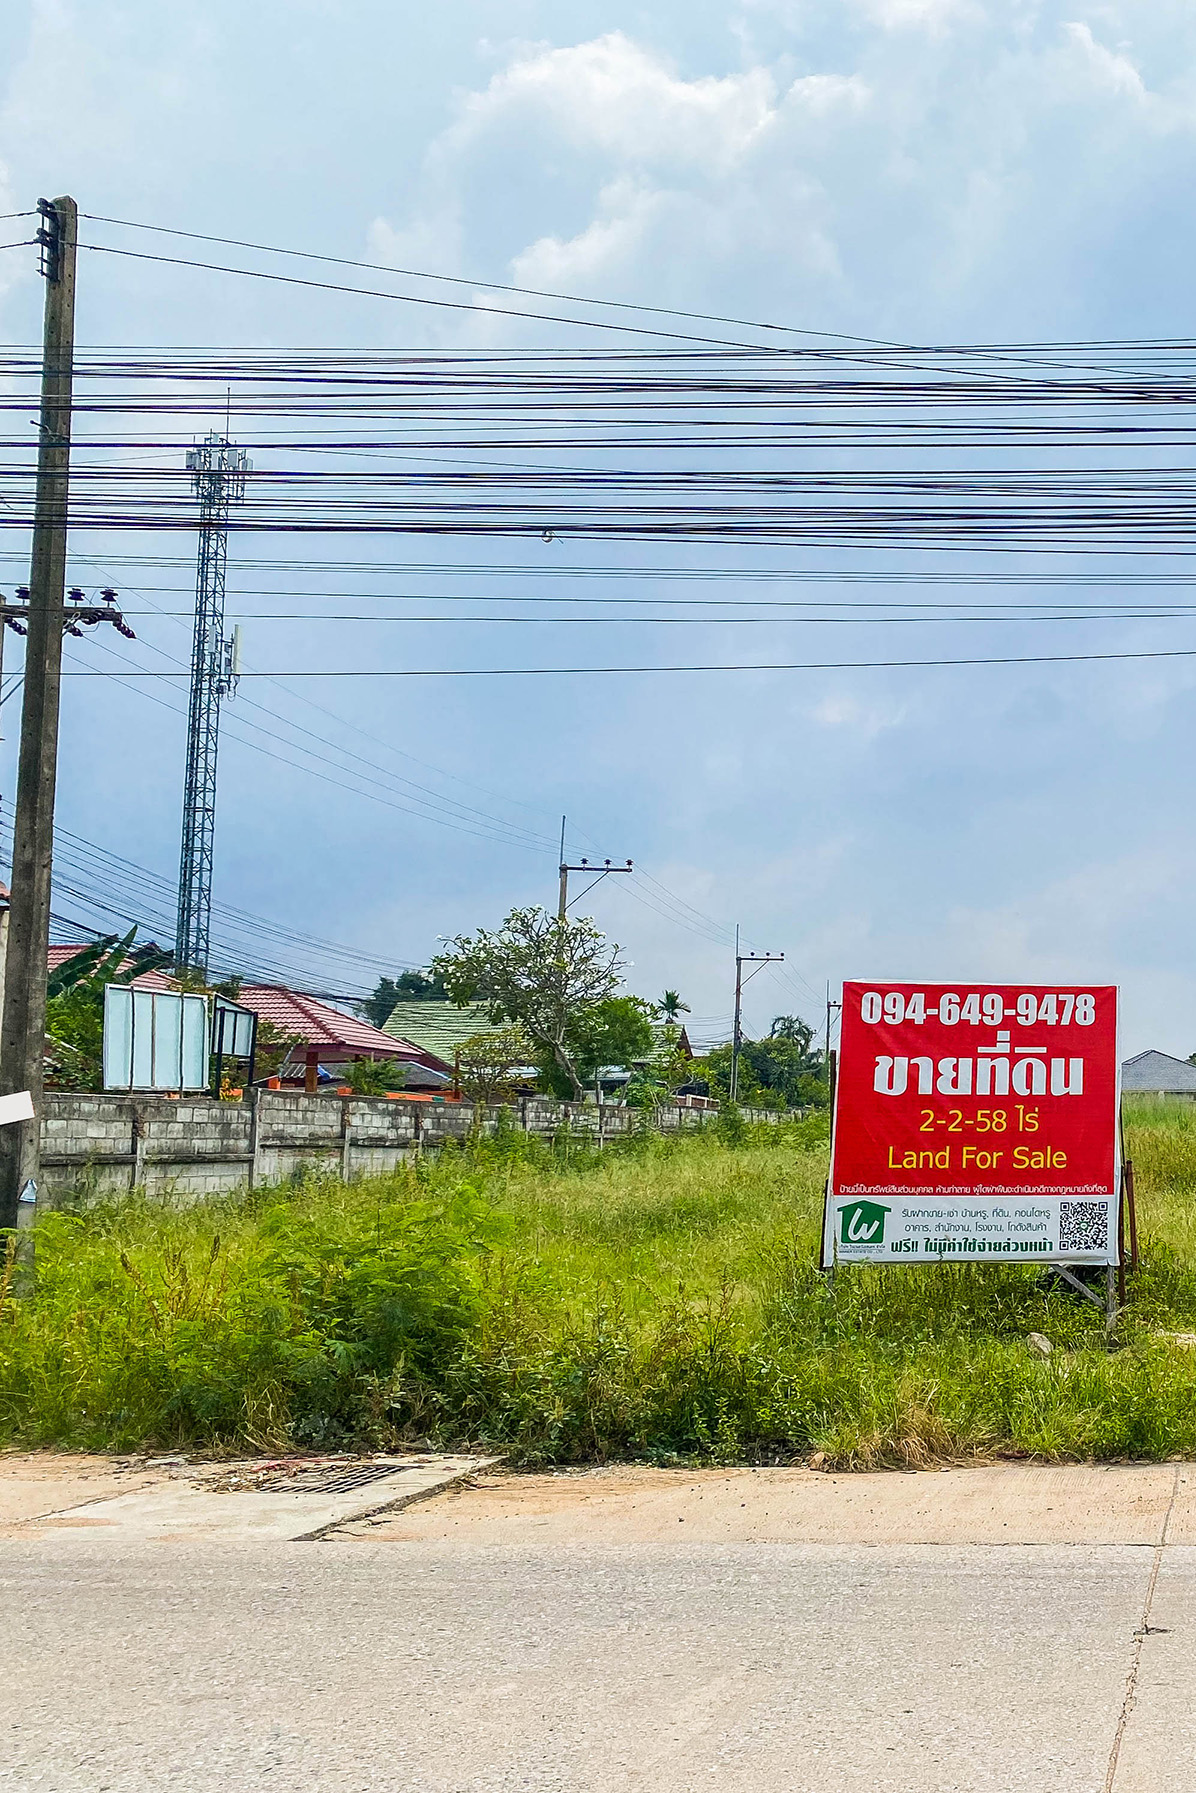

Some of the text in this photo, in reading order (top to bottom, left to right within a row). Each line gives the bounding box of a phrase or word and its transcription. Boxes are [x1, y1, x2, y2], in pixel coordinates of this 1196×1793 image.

[861, 992, 1096, 1026] 094-649-9478
[873, 1030, 1084, 1096] ขายที่ดิน
[919, 1105, 1040, 1132] 2-2-58 ไร่
[888, 1146, 1067, 1169] Land For Sale
[1014, 1207, 1050, 1220] คอนโดหรู
[1007, 1221, 1047, 1232] โกดังสินค้า
[891, 1237, 919, 1252] ฟรี!!
